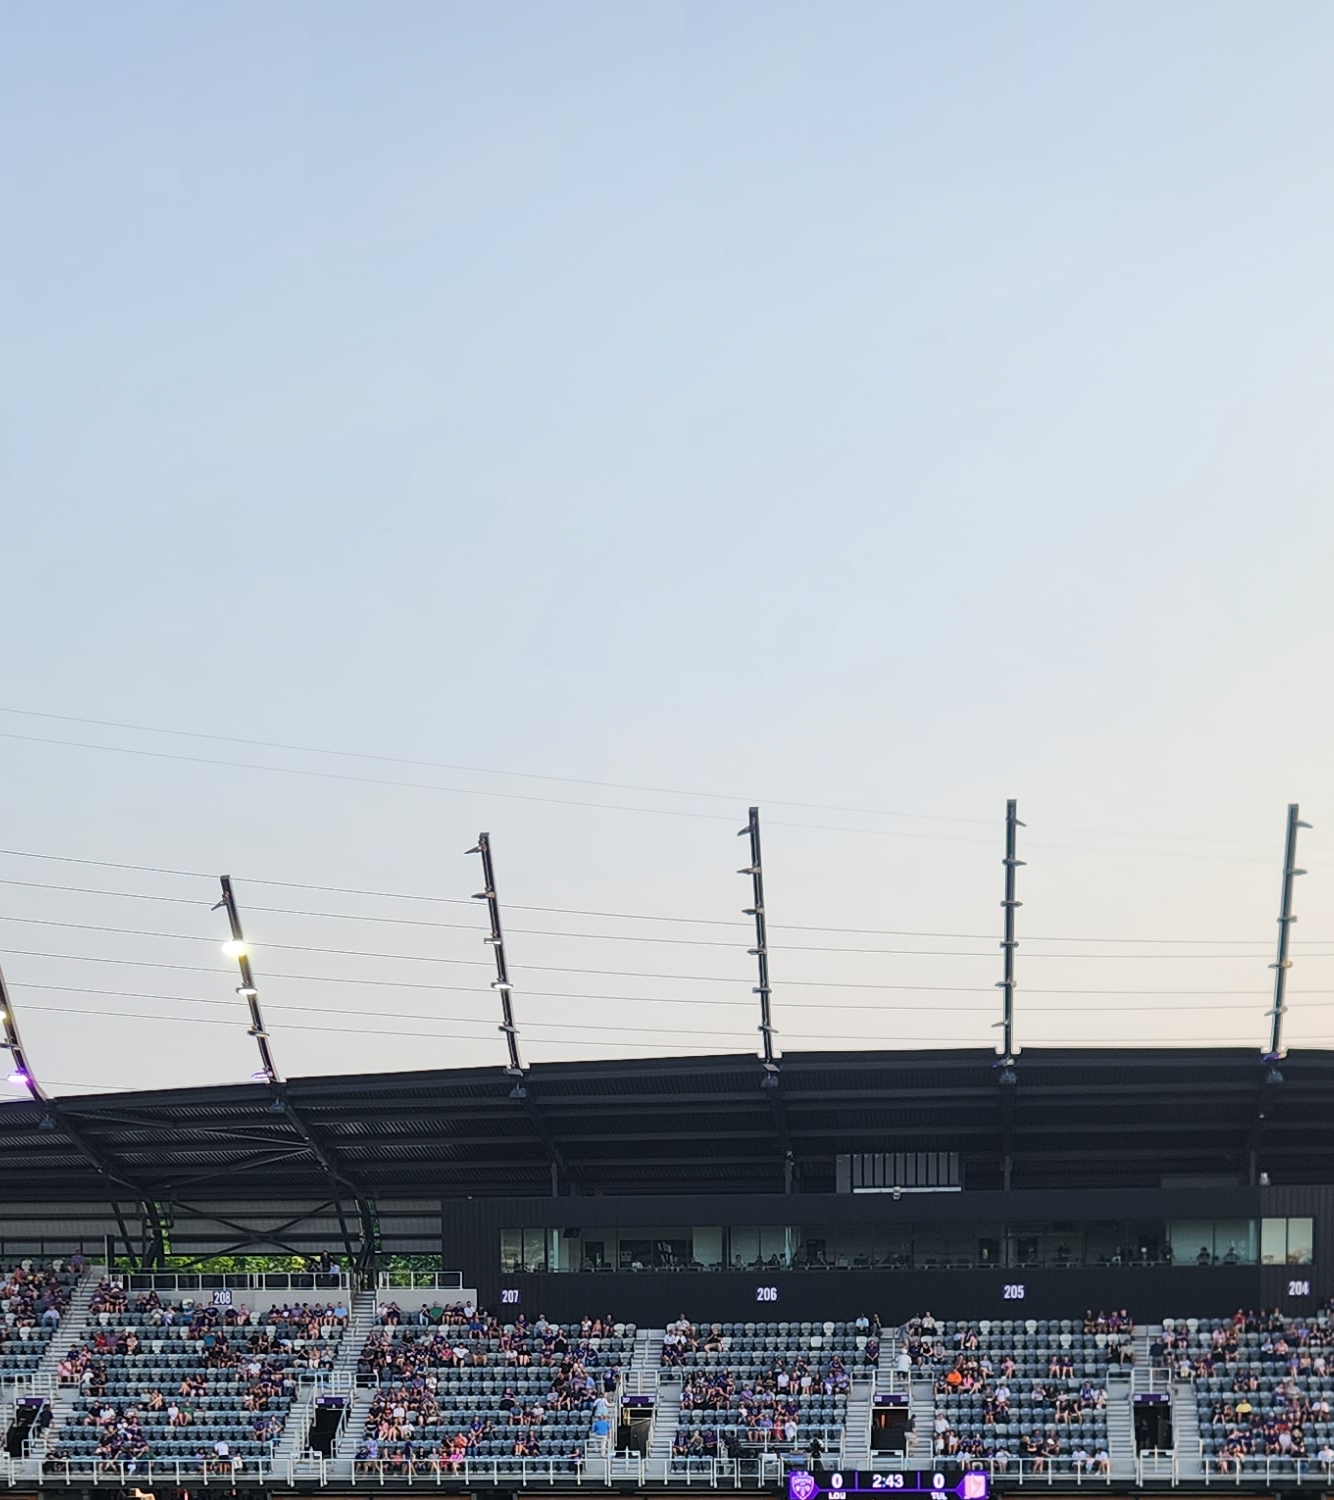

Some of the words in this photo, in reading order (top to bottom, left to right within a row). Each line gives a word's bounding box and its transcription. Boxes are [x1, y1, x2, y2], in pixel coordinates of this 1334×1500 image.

[756, 1287, 778, 1301] 206
[1003, 1285, 1025, 1299] 205
[1288, 1281, 1310, 1296] 204
[213, 1291, 231, 1305] 208
[501, 1290, 519, 1303] 207
[831, 1473, 843, 1489] 0
[872, 1474, 904, 1488] 2:43
[933, 1473, 945, 1489] 0
[828, 1492, 846, 1500] LOU
[930, 1492, 948, 1500] TUL
